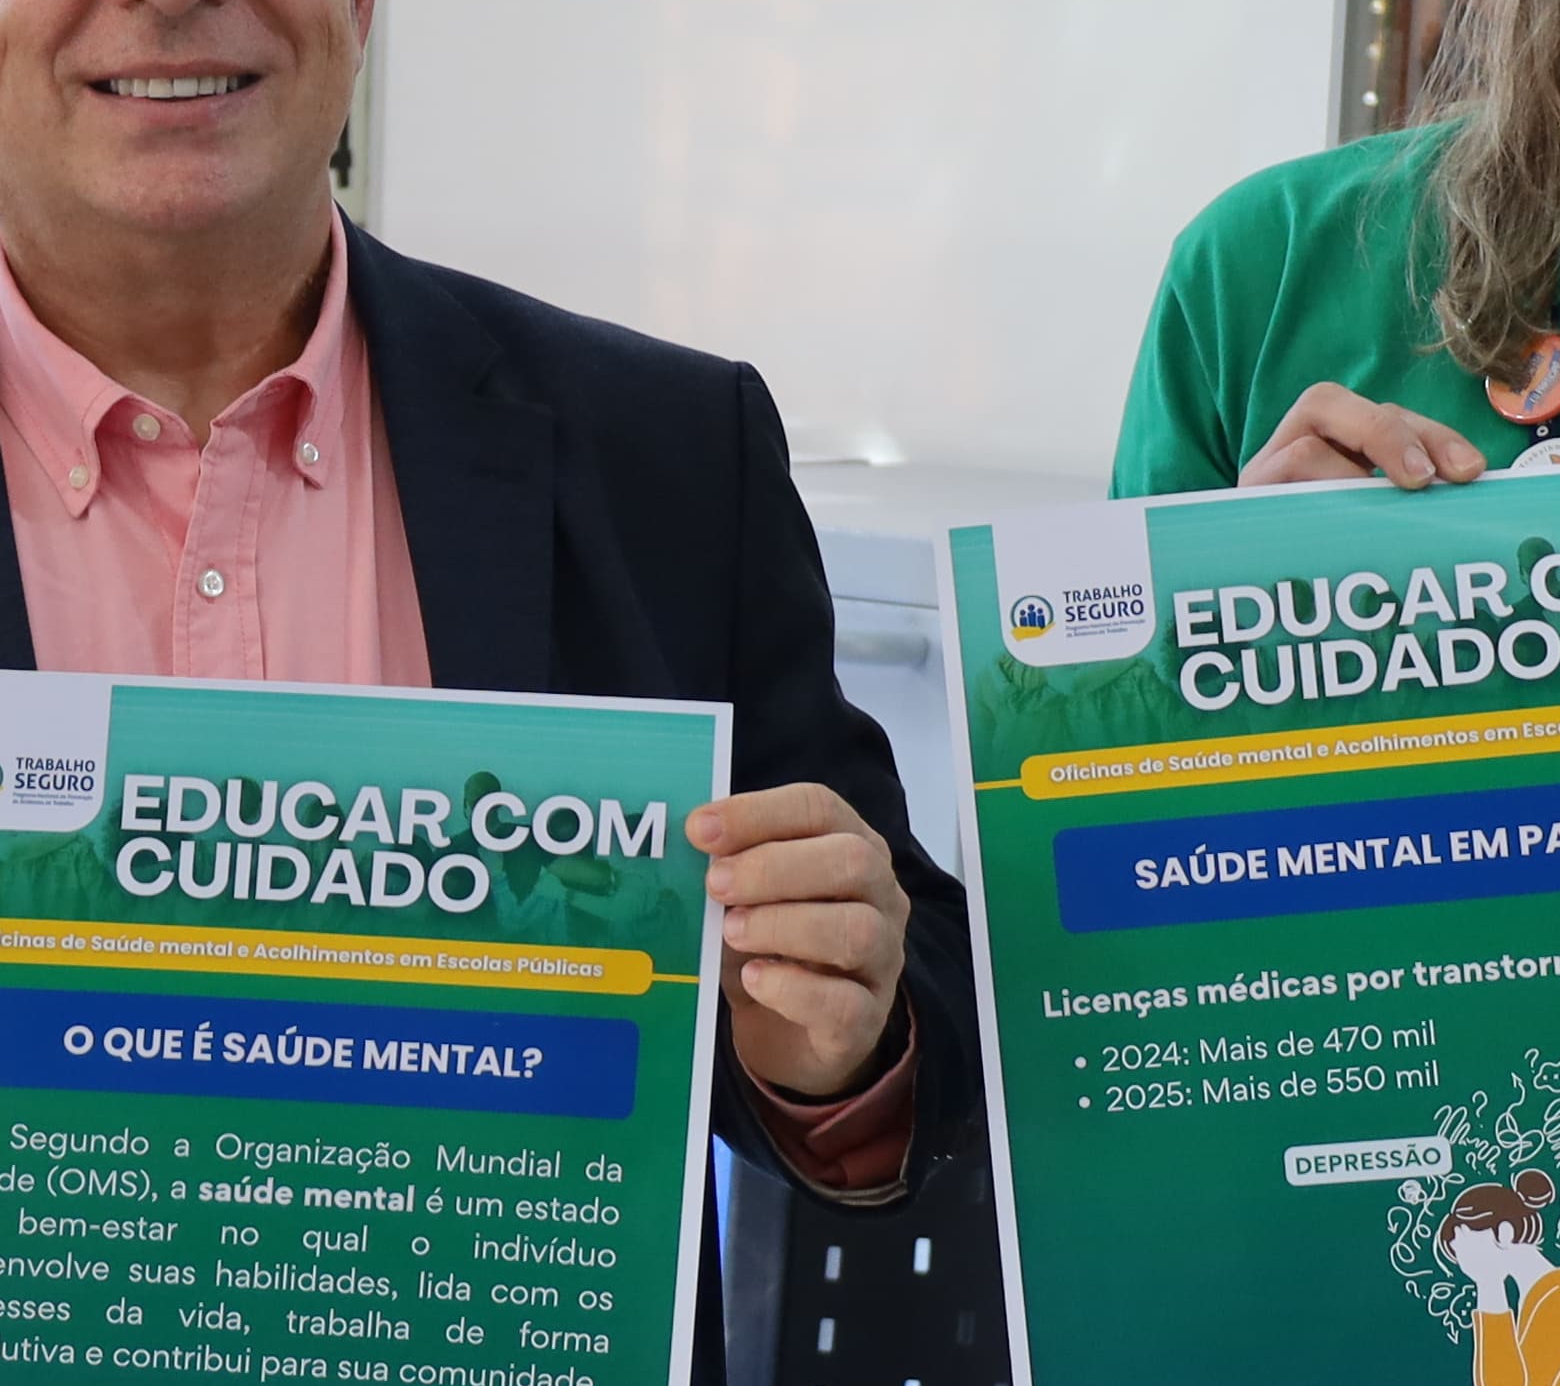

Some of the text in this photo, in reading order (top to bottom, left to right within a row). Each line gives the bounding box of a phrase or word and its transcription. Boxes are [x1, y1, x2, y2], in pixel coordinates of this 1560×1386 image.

[1062, 583, 1143, 604] TRABALHO
[1064, 598, 1145, 623] SEGURO
[1172, 561, 1515, 648] EDUCAR
[14, 771, 95, 793] SEGURO
[15, 756, 96, 773] TRABALHO
[120, 773, 668, 859] EDUCAR COM
[115, 836, 490, 914] CUIDADO
[1134, 844, 1269, 890] SAÚDE
[1276, 833, 1442, 878] MENTAL
[1449, 827, 1509, 863] EM
[59, 933, 88, 951] de
[90, 934, 157, 954] Saúde
[158, 940, 235, 958] mental
[236, 944, 250, 959] e
[252, 942, 396, 966] Acolhimentos
[398, 953, 434, 968] em
[436, 952, 514, 973] Escolas
[516, 956, 604, 978] Públicas
[1042, 986, 1189, 1019] Licenças
[1196, 970, 1338, 1005] médicas
[1346, 968, 1405, 1001] por
[63, 1021, 543, 1079] O QUE É SAÚDE MENTAL?
[1101, 1019, 1437, 1073] 2024: Mais de 470 mil
[1105, 1059, 1440, 1113] 2025: Mais de 550 mil
[9, 1123, 623, 1183] Segundo a Organização Mundial da
[1295, 1143, 1442, 1176] DEPRESSÃO
[46, 1164, 159, 1203] (OMS),
[170, 1180, 187, 1200] a
[198, 1175, 294, 1206] saúde
[303, 1184, 416, 1213] mental
[425, 1186, 444, 1215] é
[455, 1196, 504, 1218] um
[515, 1196, 621, 1226] estado
[17, 1206, 179, 1242] bem-estar
[220, 1225, 260, 1247] no
[302, 1224, 368, 1258] qual
[410, 1235, 431, 1256] o
[473, 1232, 617, 1269] indivíduo
